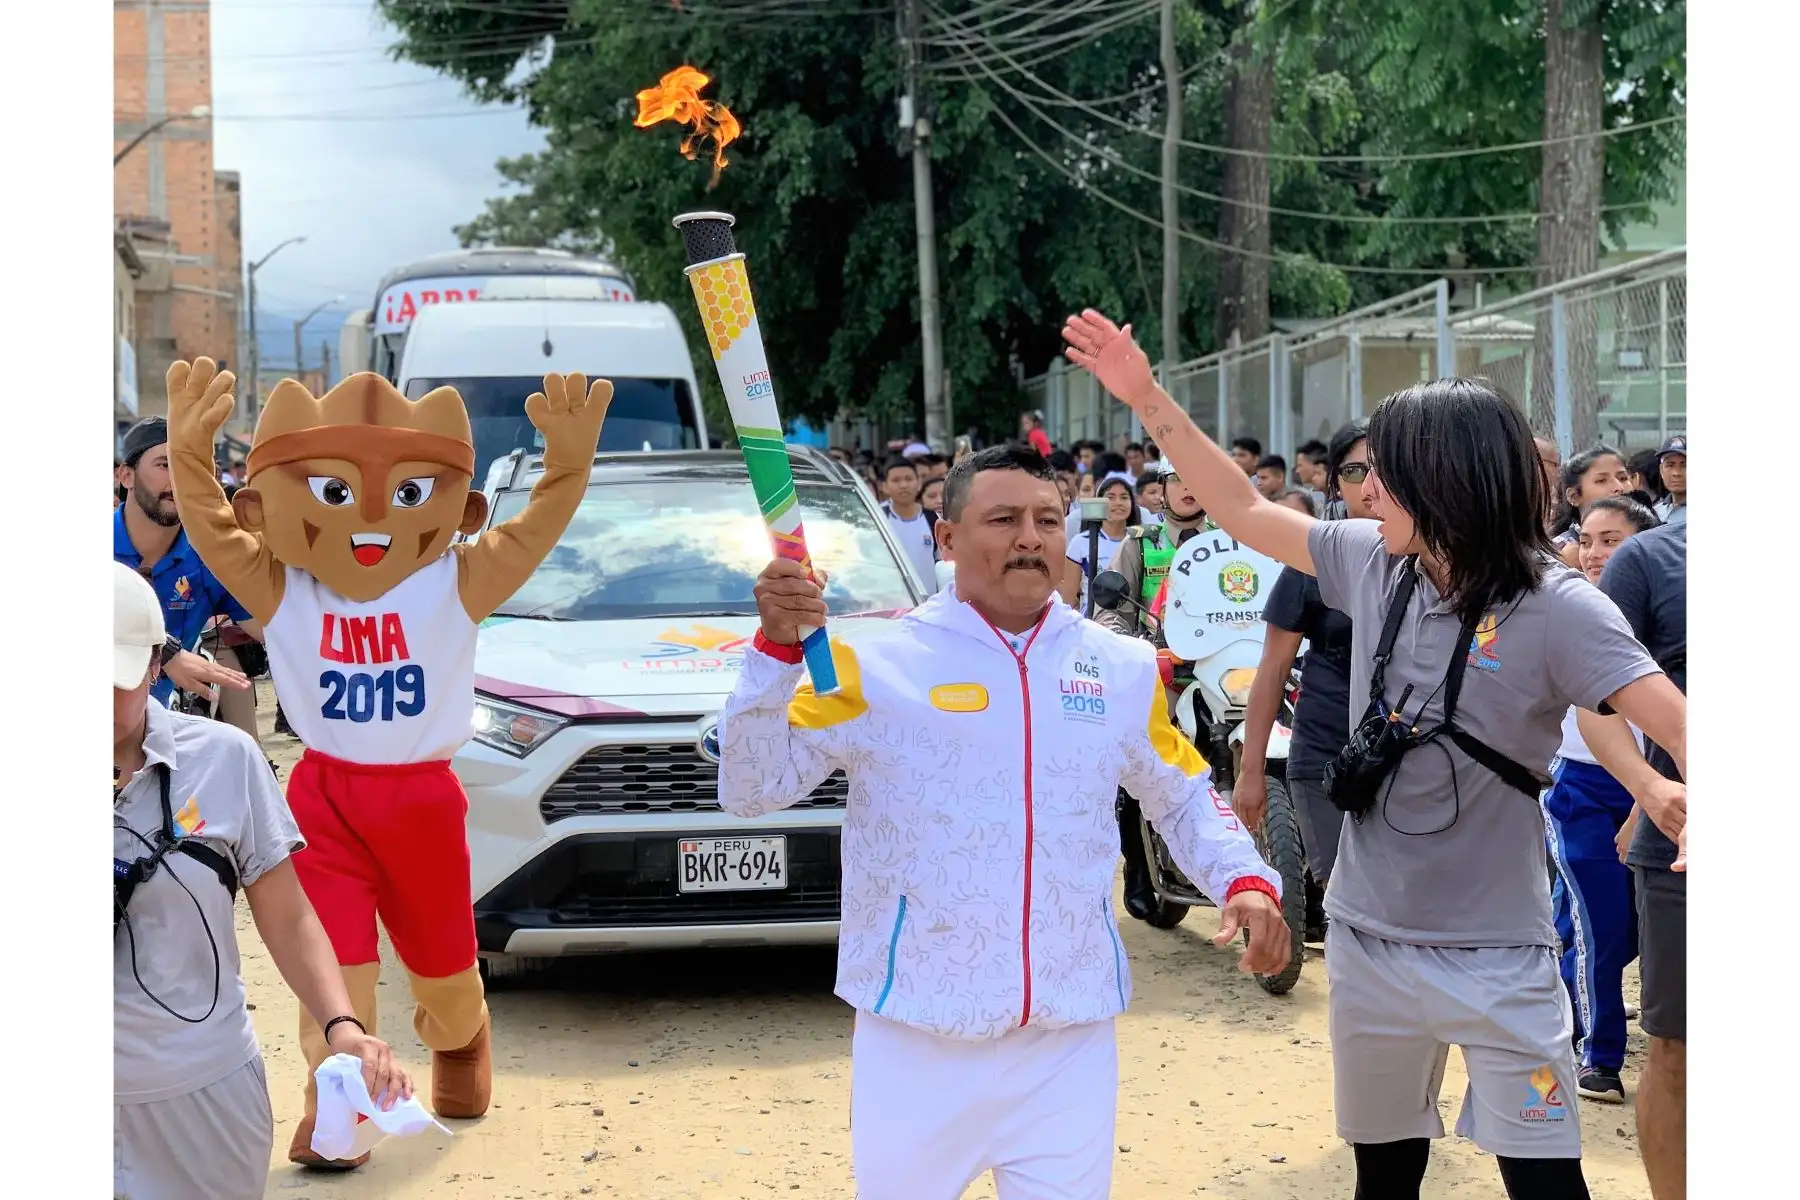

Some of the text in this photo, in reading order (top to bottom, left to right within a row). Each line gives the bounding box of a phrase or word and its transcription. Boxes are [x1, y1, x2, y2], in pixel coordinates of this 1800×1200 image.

[1177, 538, 1240, 576] POLI
[1206, 610, 1263, 624] TRANSI
[319, 612, 410, 665] LIMA
[1074, 661, 1100, 678] 045
[319, 664, 426, 723] 2019
[1061, 695, 1106, 715] 2019
[714, 840, 751, 852] PERU
[684, 850, 781, 883] BKR-694
